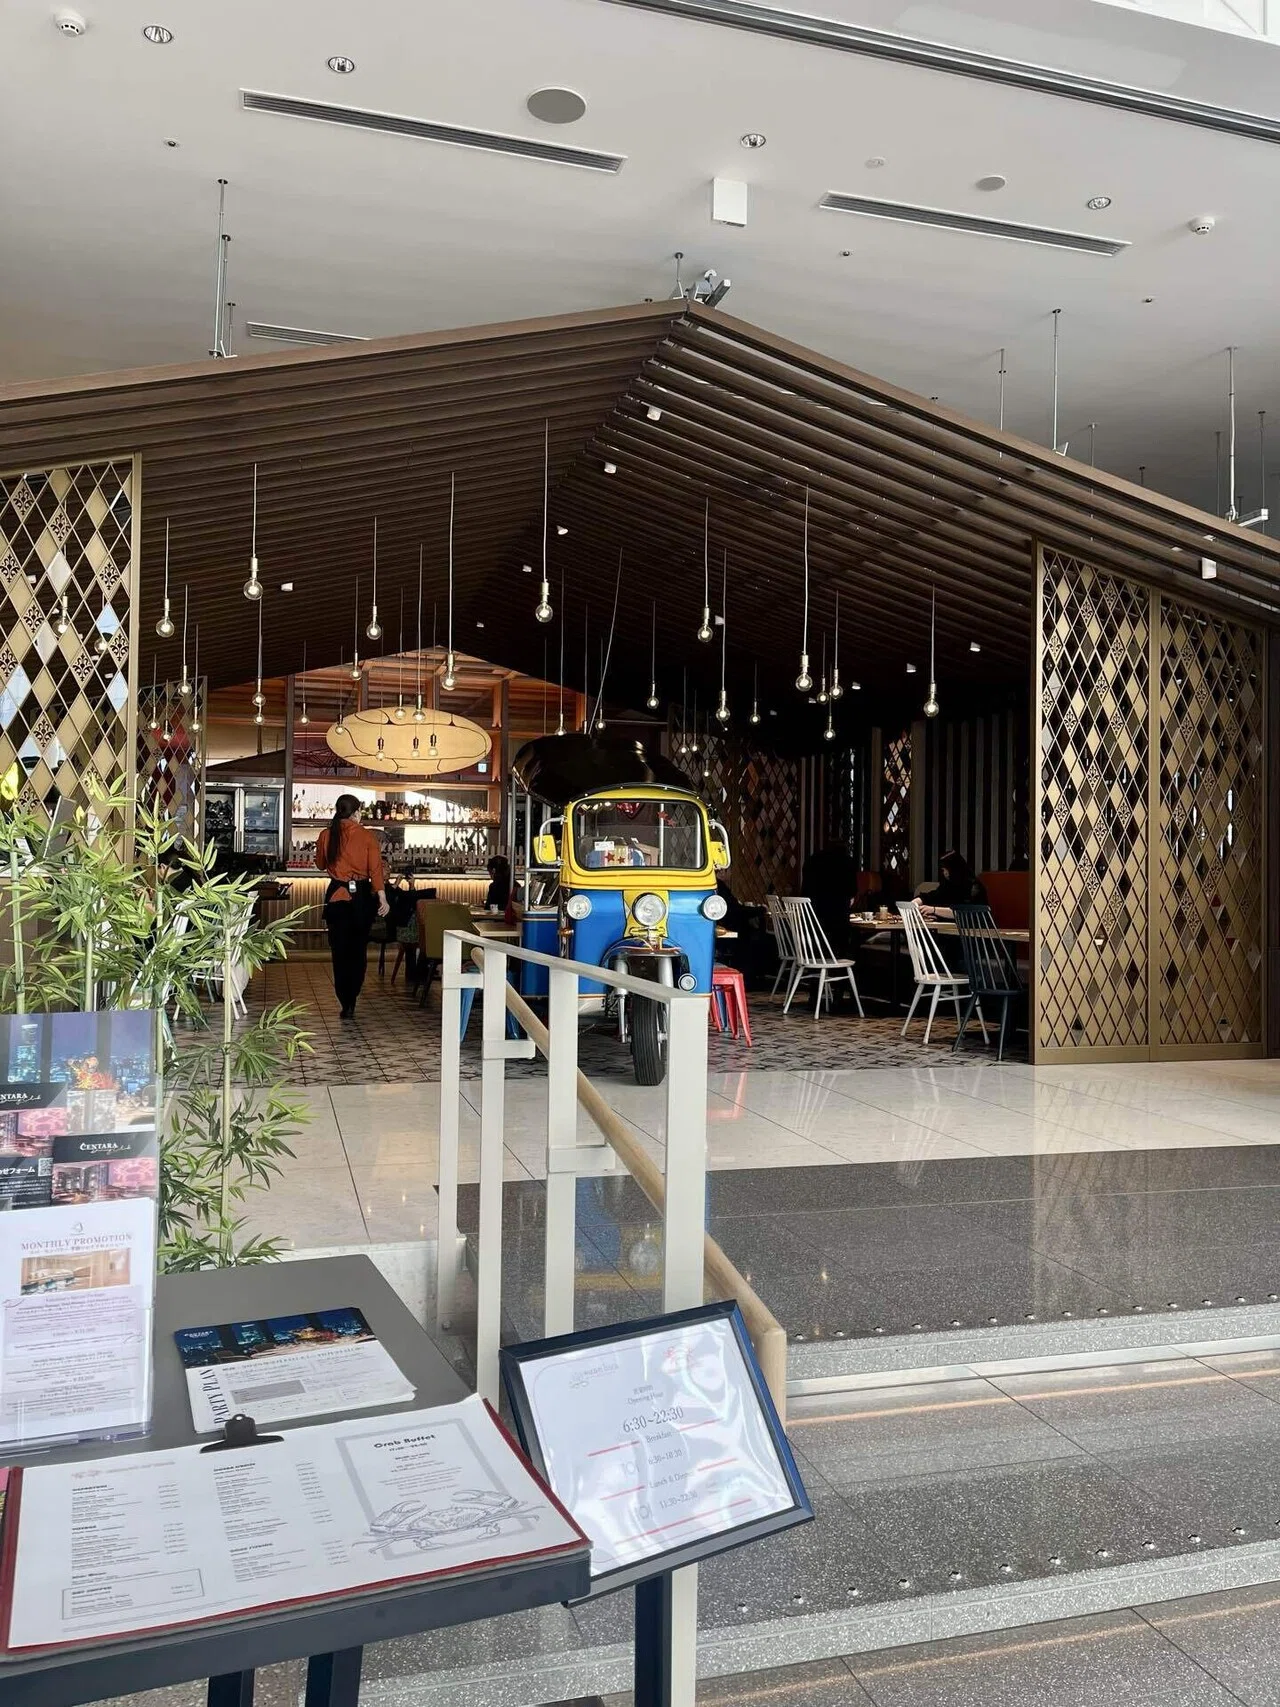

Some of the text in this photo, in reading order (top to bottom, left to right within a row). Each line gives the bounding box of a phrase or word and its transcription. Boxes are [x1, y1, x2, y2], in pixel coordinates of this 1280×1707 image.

[80, 1142, 119, 1151] CENTARA
[21, 1239, 70, 1251] MONTHLY
[73, 1232, 132, 1246] PROMOTION
[199, 1368, 231, 1424] PARTY PLAN
